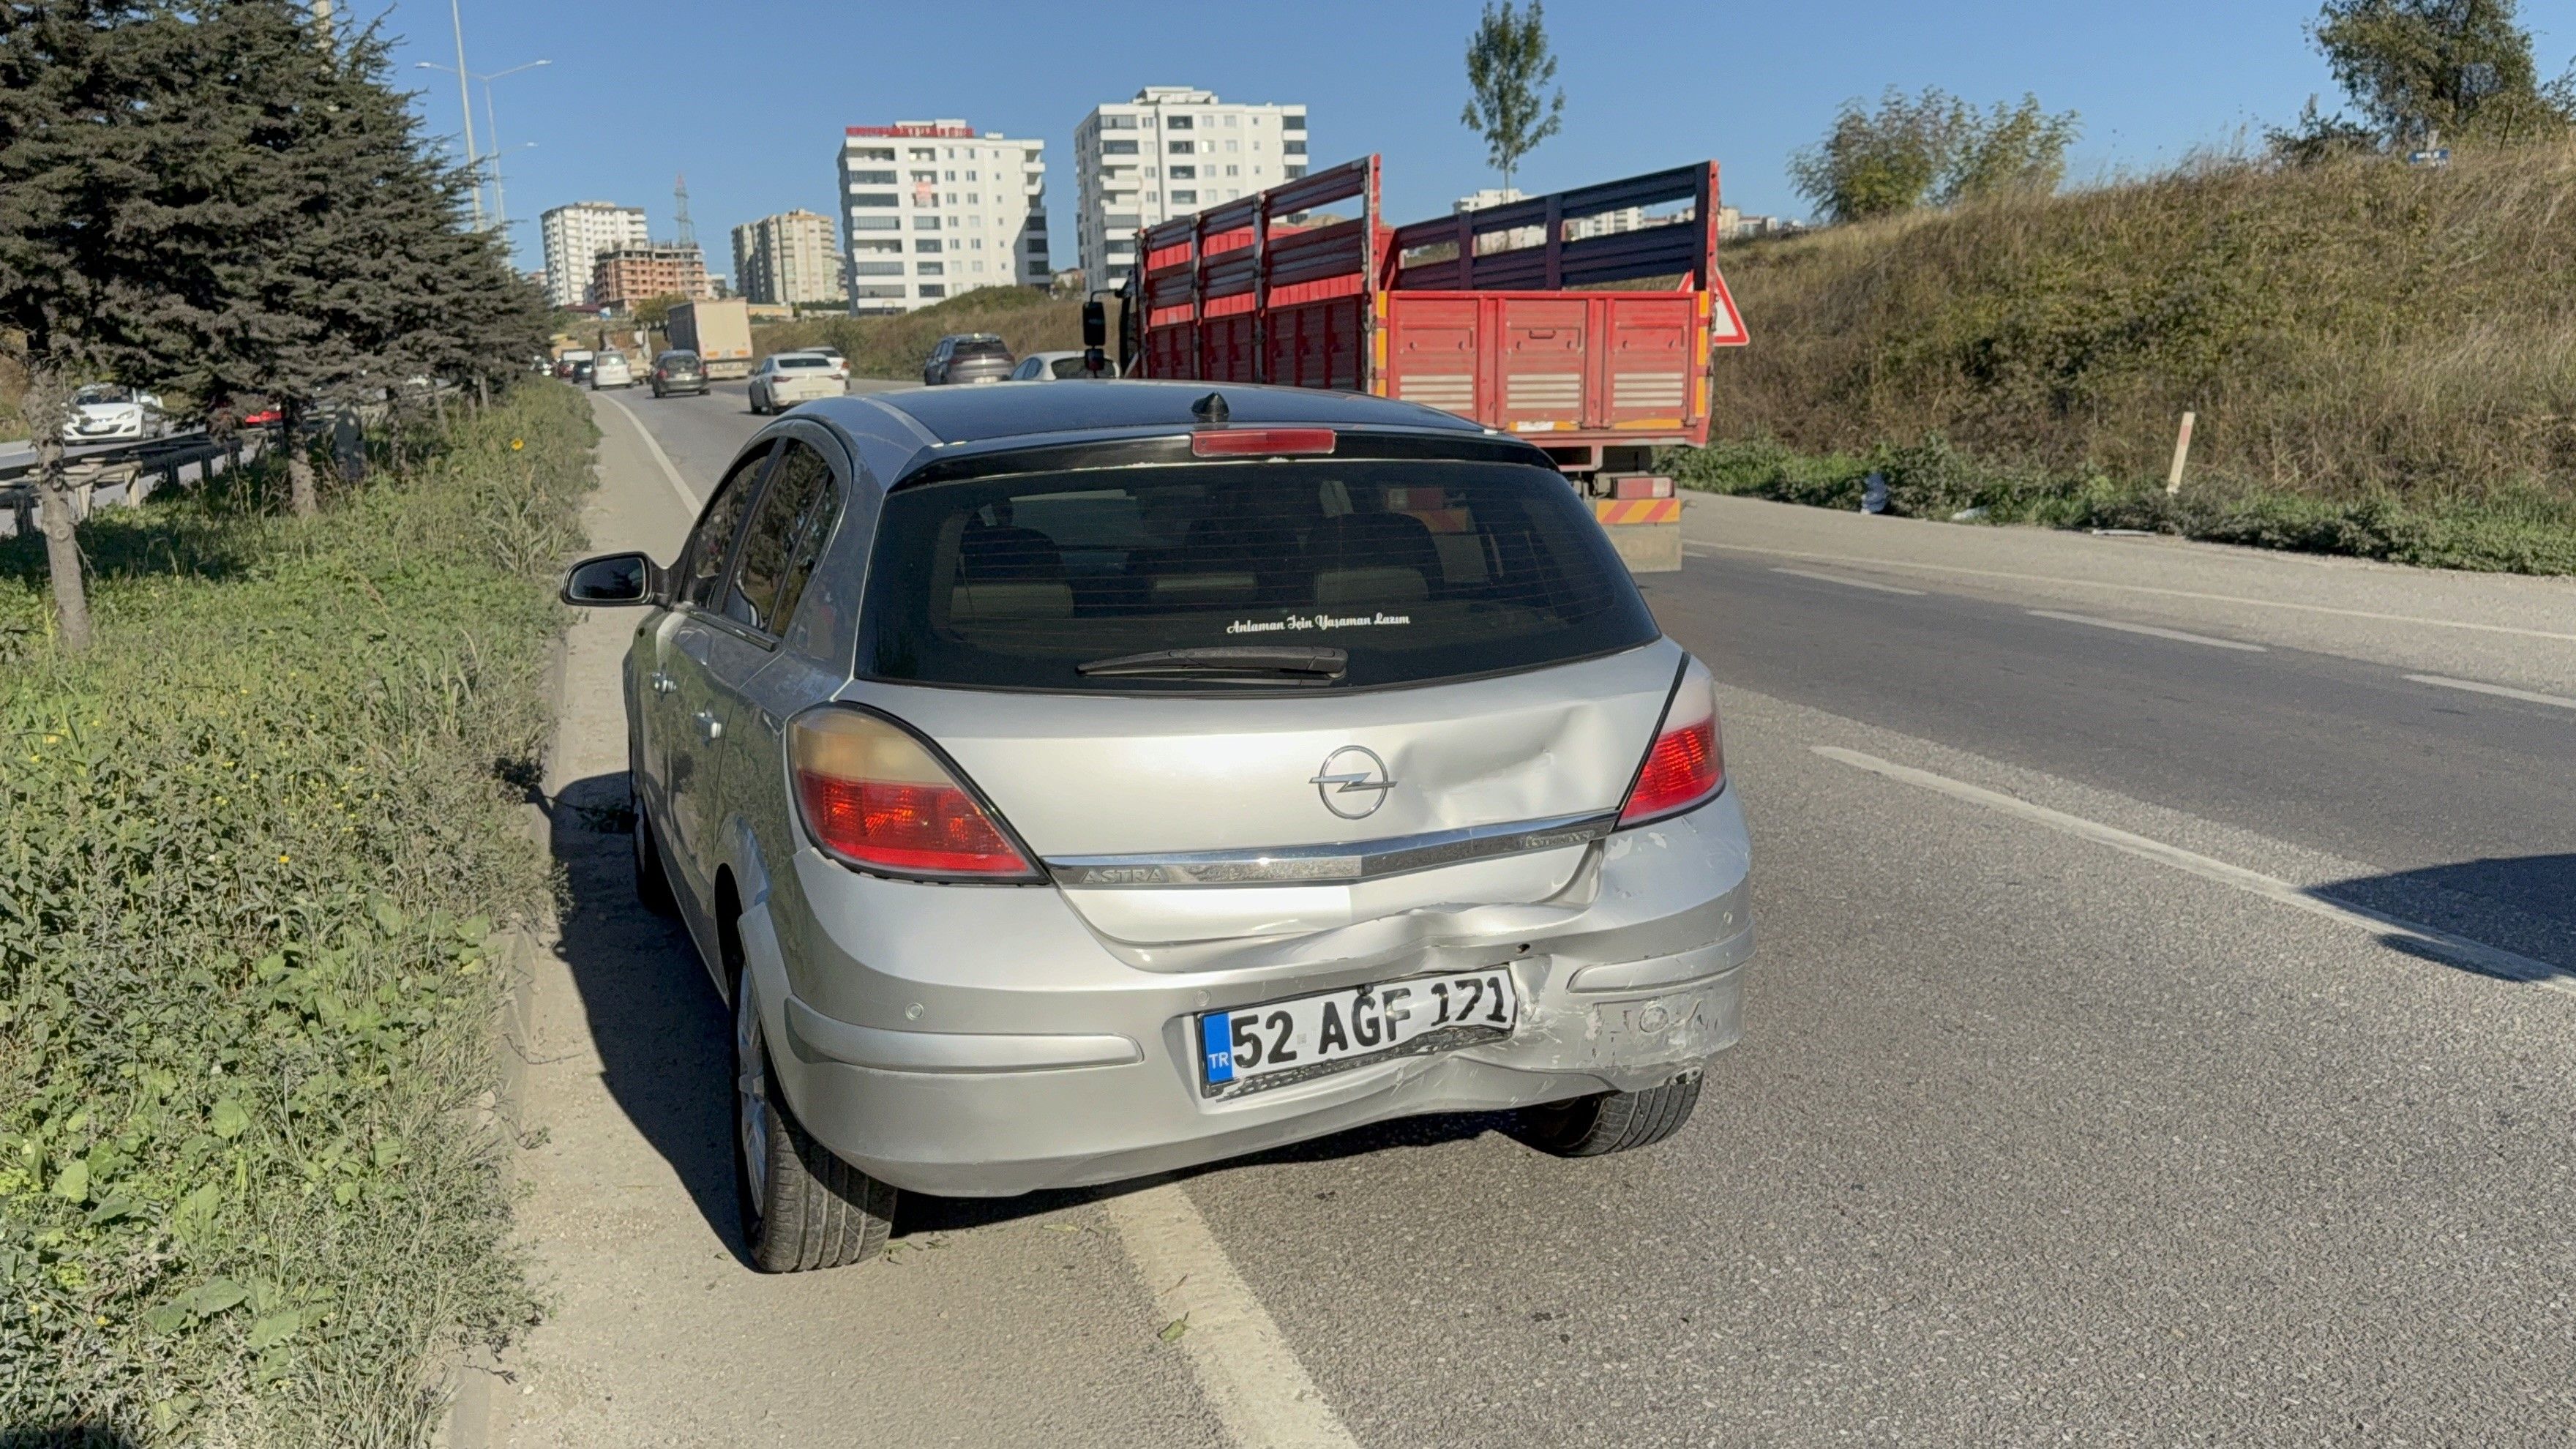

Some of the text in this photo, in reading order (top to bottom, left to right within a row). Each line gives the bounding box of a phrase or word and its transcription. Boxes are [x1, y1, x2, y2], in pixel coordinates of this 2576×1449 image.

[1227, 612, 1410, 633] Anlaman İçin Yaşaman Lazım
[1081, 868, 1166, 883] ASTRA
[1231, 976, 1508, 1068] 52 AGF 171
[1208, 1052, 1229, 1070] TR
